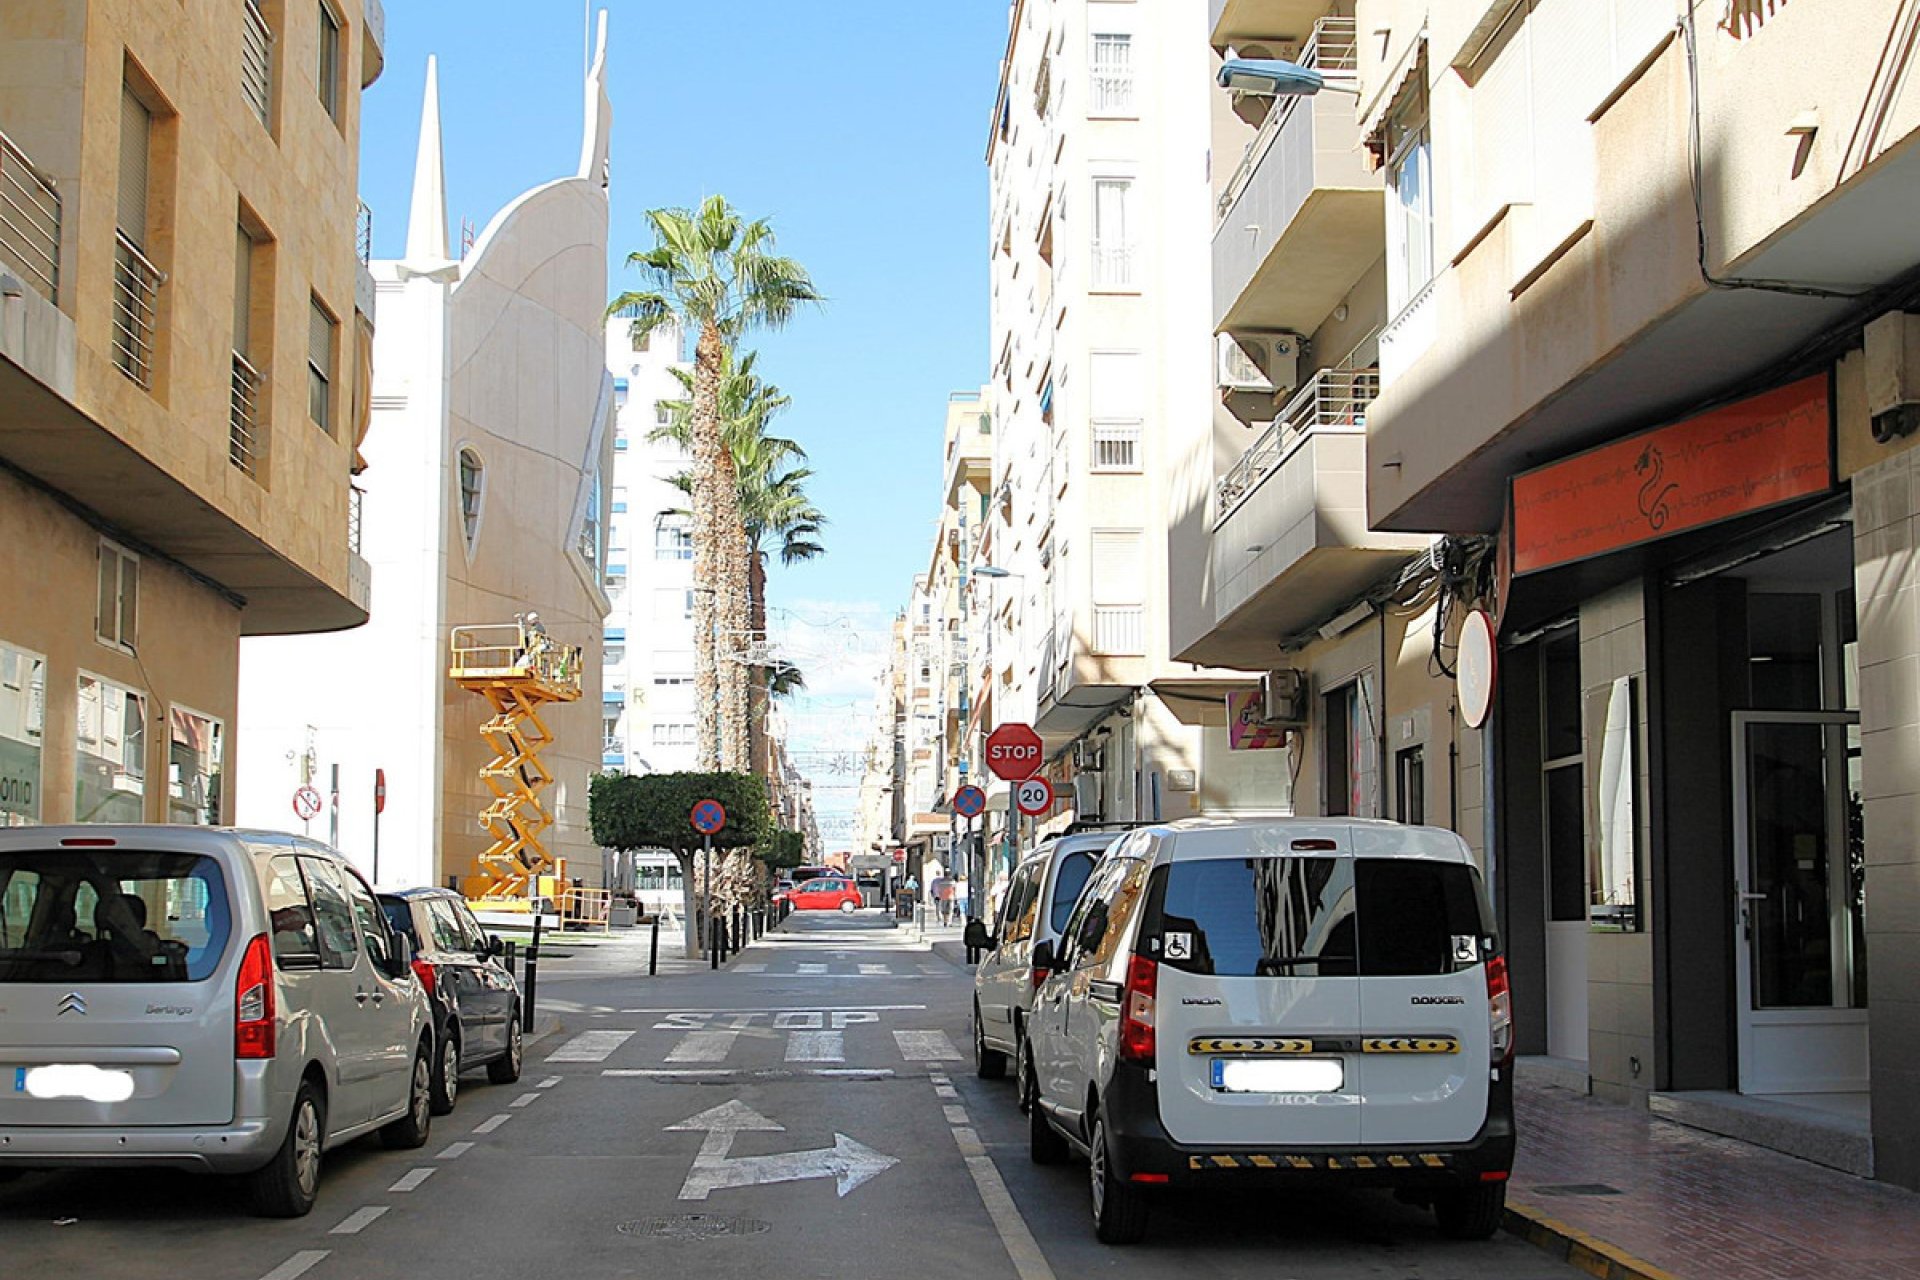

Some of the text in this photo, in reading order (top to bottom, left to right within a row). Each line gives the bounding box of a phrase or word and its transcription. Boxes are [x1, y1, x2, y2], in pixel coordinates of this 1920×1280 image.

[991, 745, 1038, 759] STOP
[1022, 789, 1044, 802] 20
[145, 1003, 193, 1016] Berlingo
[652, 1011, 881, 1029] STOP
